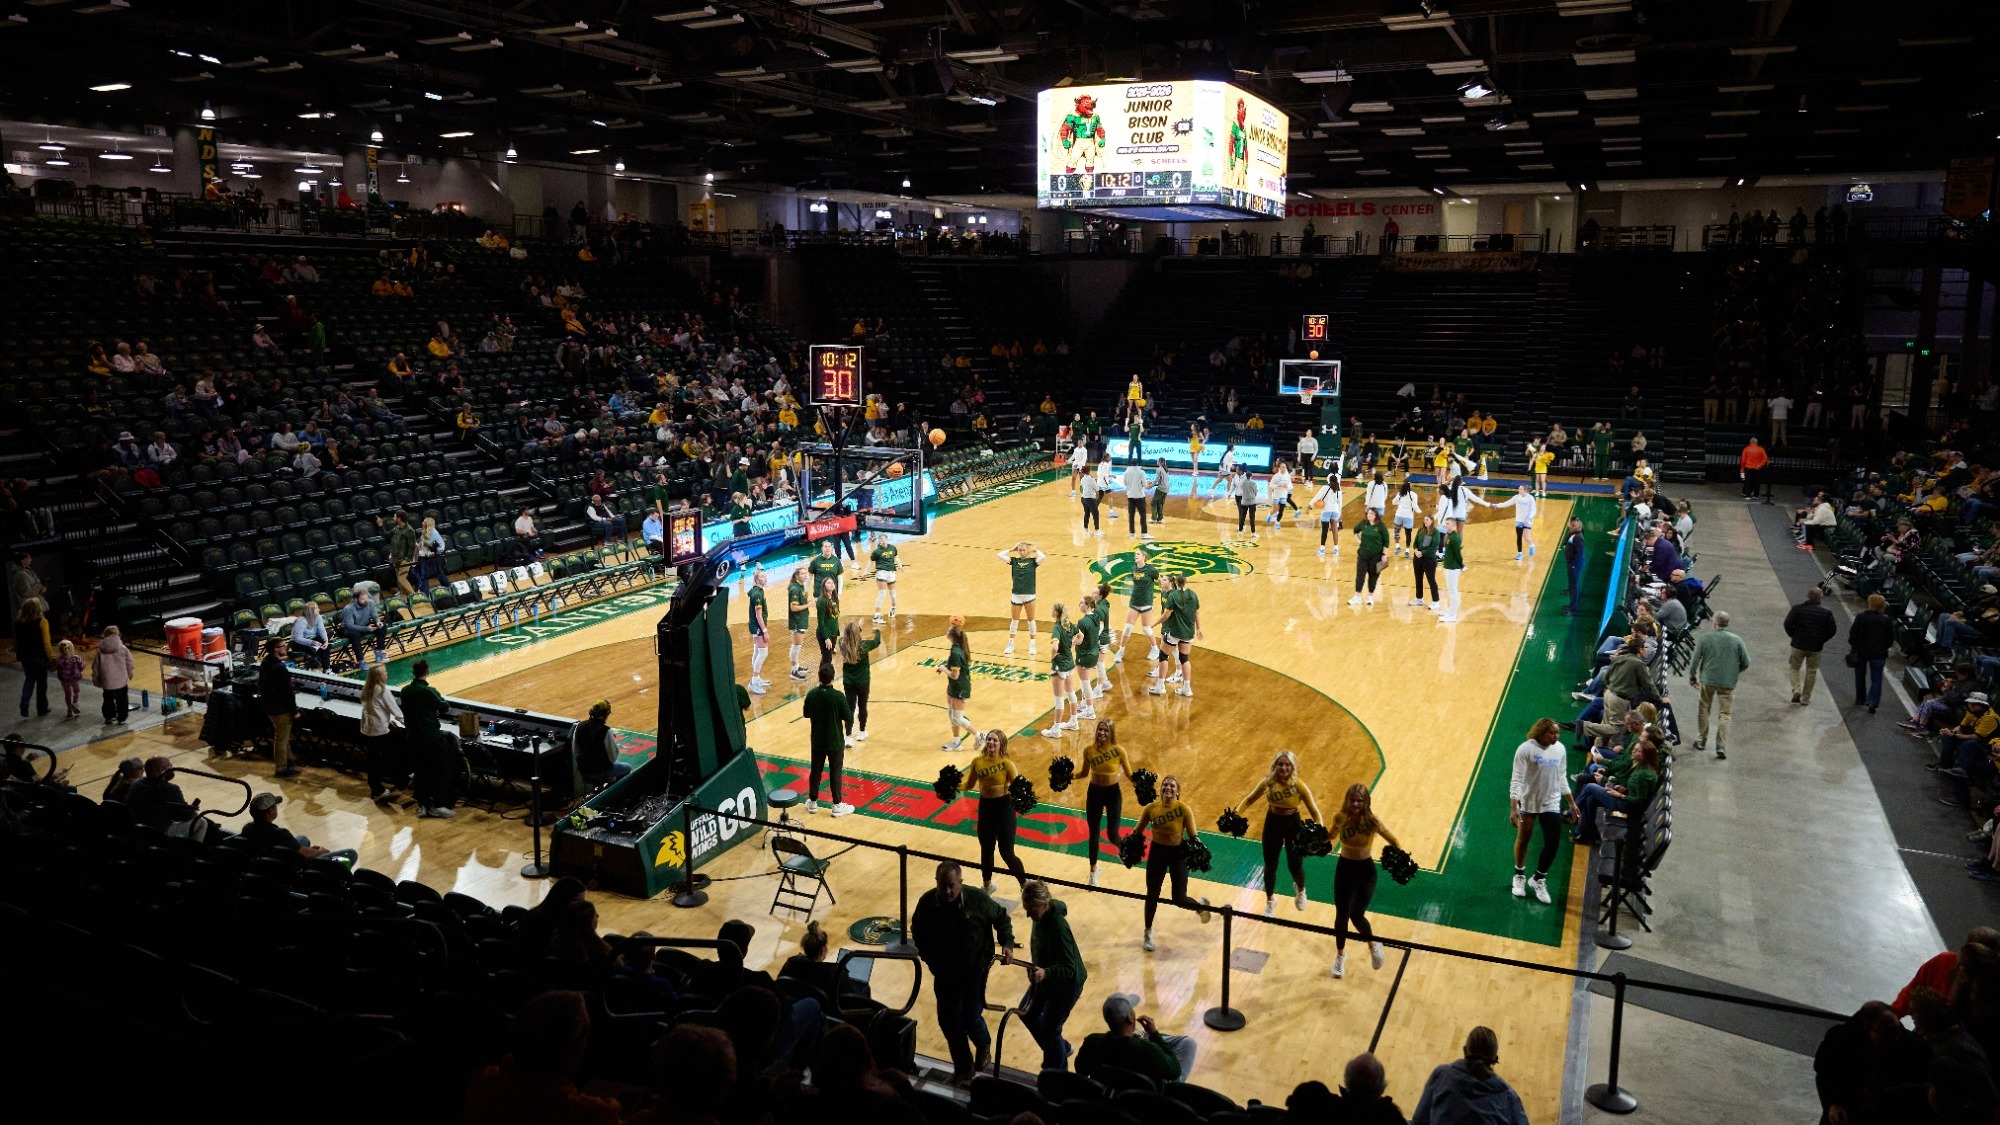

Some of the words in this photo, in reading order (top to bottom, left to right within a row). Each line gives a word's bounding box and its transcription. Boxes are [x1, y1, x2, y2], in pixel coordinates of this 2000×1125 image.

[1124, 100, 1172, 113] JUNIOR
[1128, 115, 1168, 128] BISON
[1131, 131, 1164, 144] CLUB
[198, 128, 216, 179] NDS
[1101, 174, 1130, 187] 10:12
[1382, 204, 1435, 216] CENTER
[1309, 325, 1323, 338] 30
[822, 352, 857, 368] 10:12
[824, 369, 852, 398] 30
[1090, 747, 1120, 768] NDSU
[978, 762, 1006, 778] NDSU
[690, 813, 716, 830] UFFAL
[718, 786, 757, 842] GO
